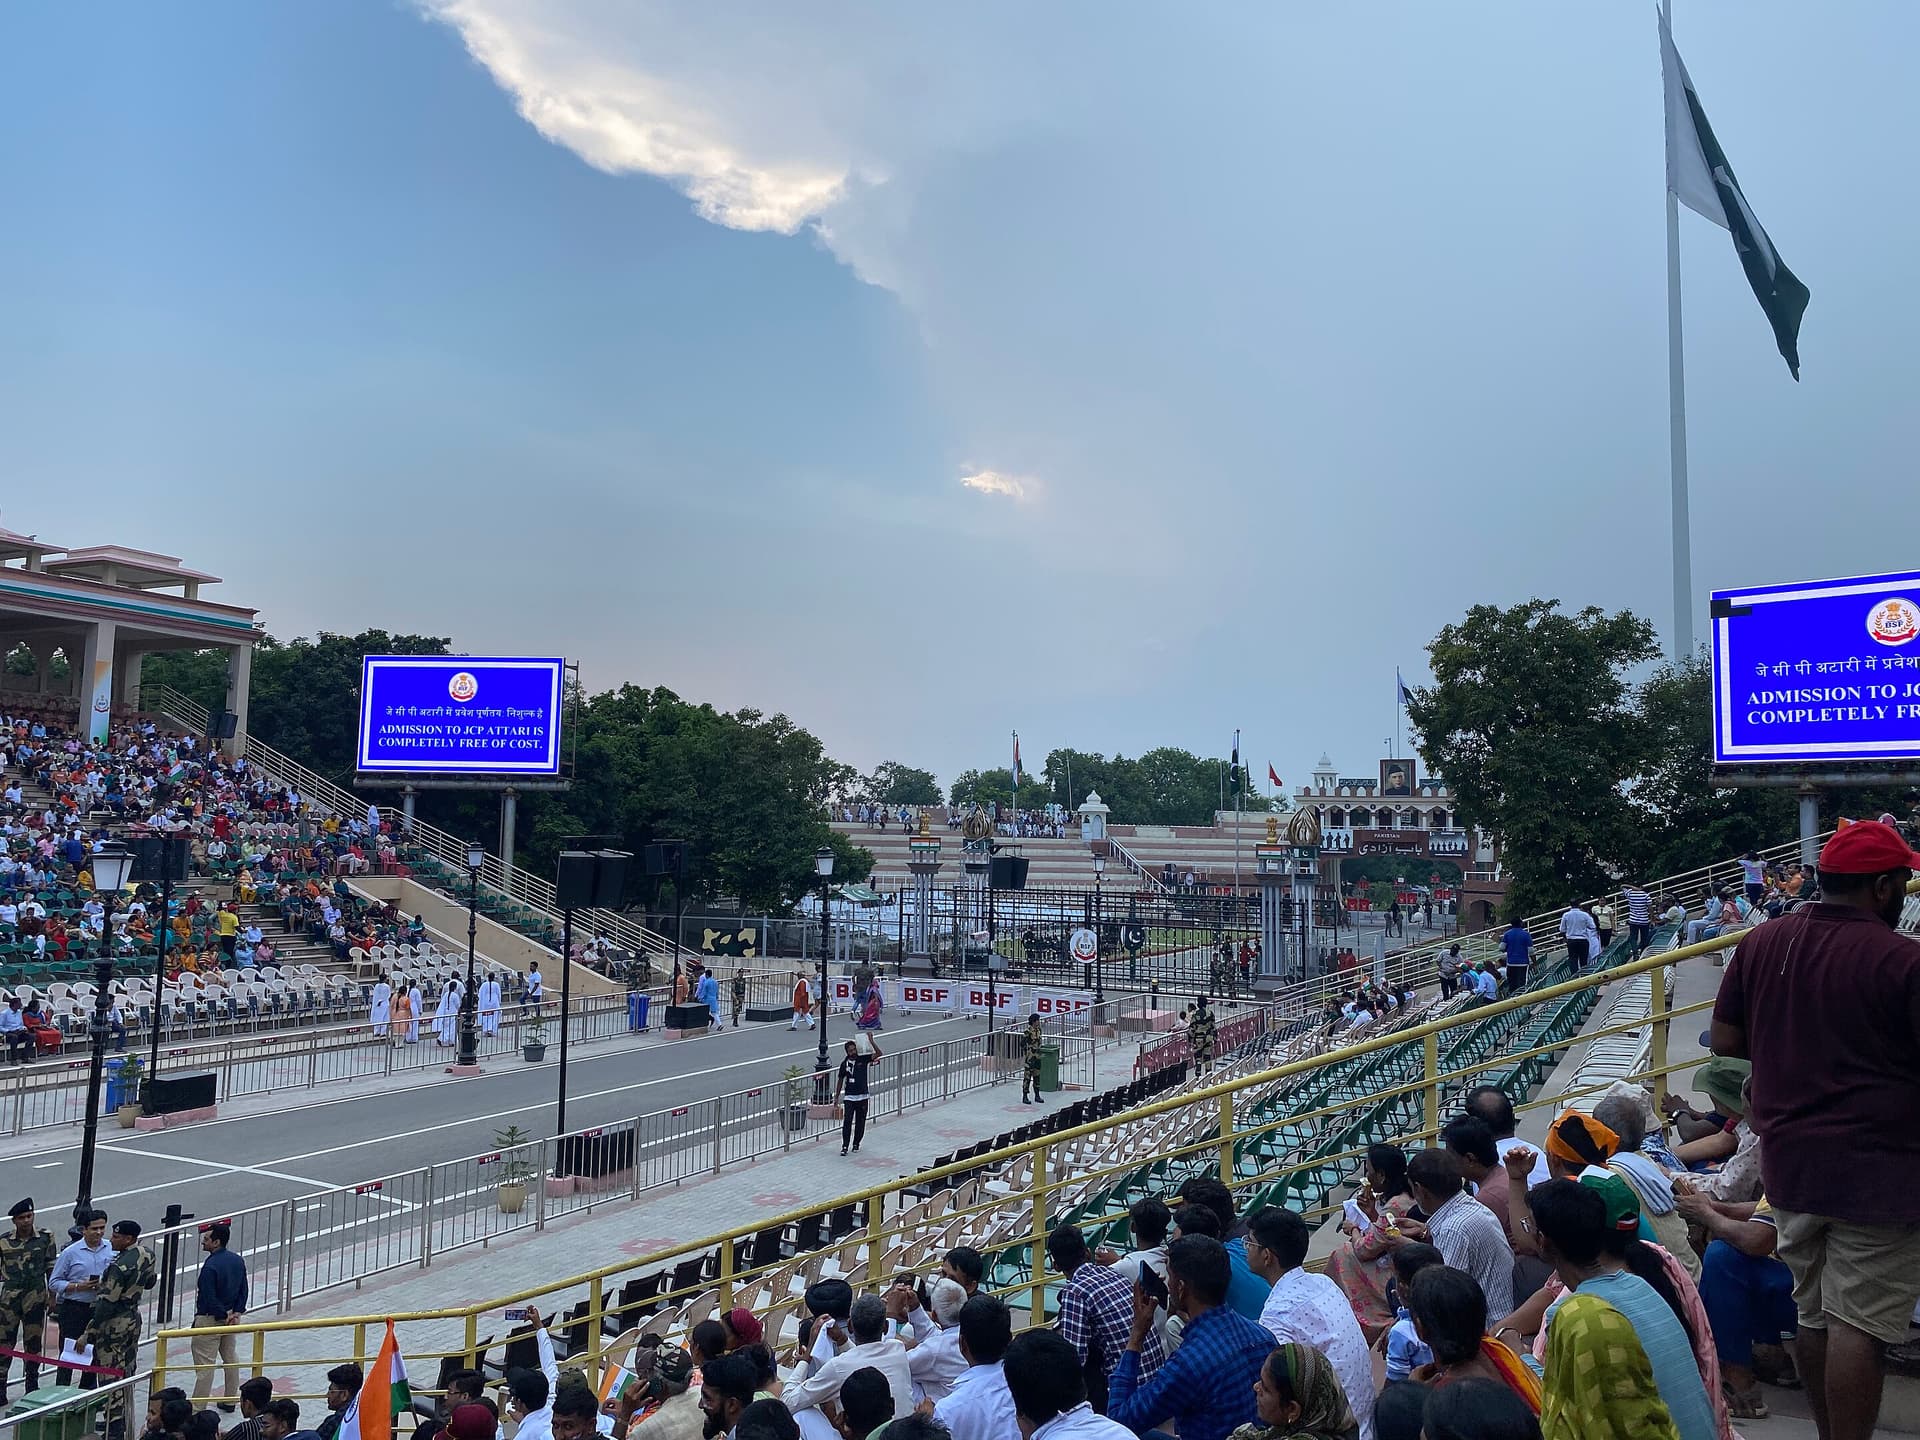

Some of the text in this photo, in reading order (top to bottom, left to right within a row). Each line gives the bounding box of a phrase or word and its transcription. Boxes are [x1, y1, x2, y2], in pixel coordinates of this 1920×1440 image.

[1755, 653, 1920, 677] जे सी पी अटारी में प्रवेश
[1747, 686, 1862, 704] ADMISSION
[1866, 684, 1897, 699] TO
[1747, 705, 1889, 724] COMPLETELY
[379, 725, 544, 736] ADMISSION TO JCP ATTARI IS
[378, 737, 543, 749] COMPLETELY FREE OF COST.
[904, 987, 949, 1003] BSF
[970, 991, 1013, 1008] BSF
[1037, 998, 1090, 1015] BSF
